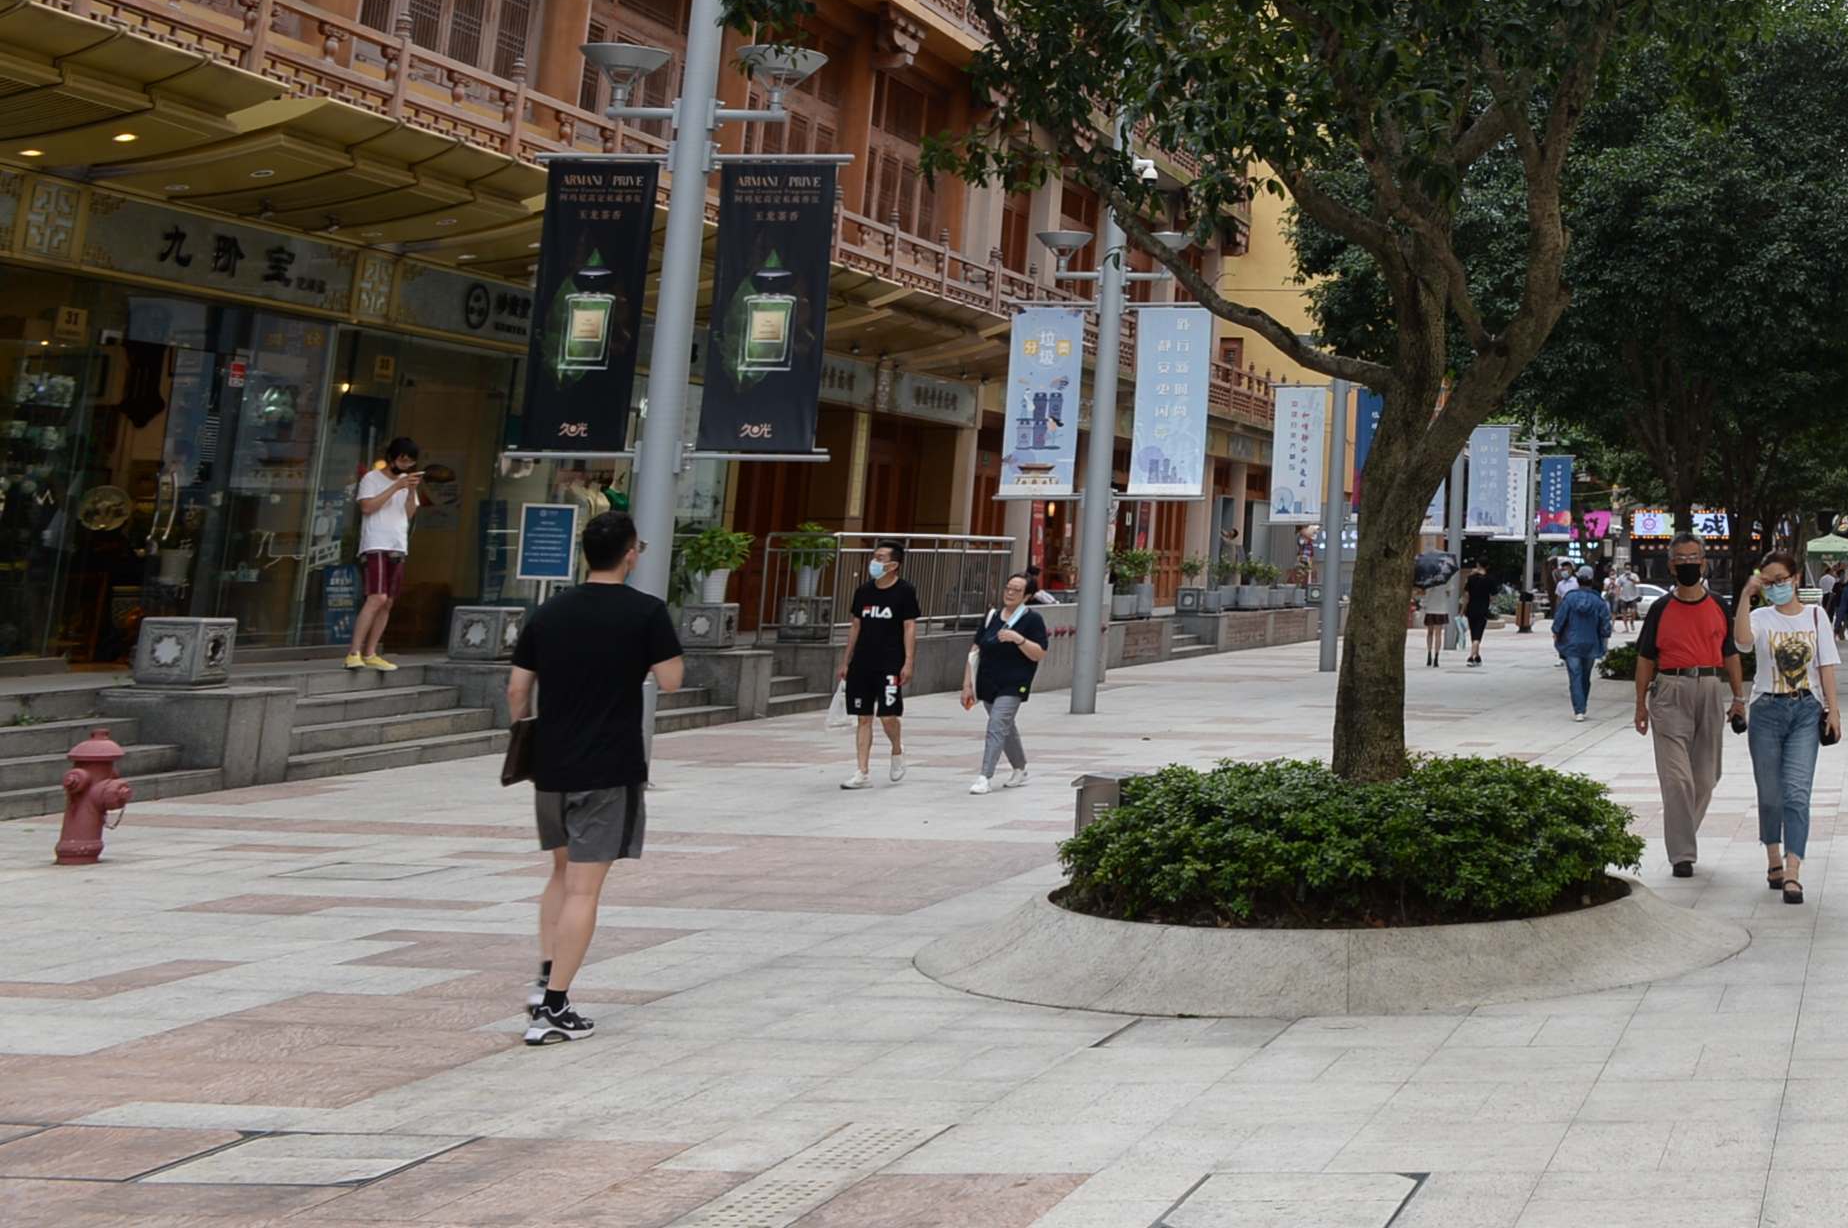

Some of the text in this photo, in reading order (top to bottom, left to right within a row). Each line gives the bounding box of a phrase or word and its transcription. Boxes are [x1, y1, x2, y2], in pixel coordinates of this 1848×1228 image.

[563, 175, 602, 187] ARMANI
[736, 175, 778, 188] ARMANI
[862, 604, 893, 620] FILA
